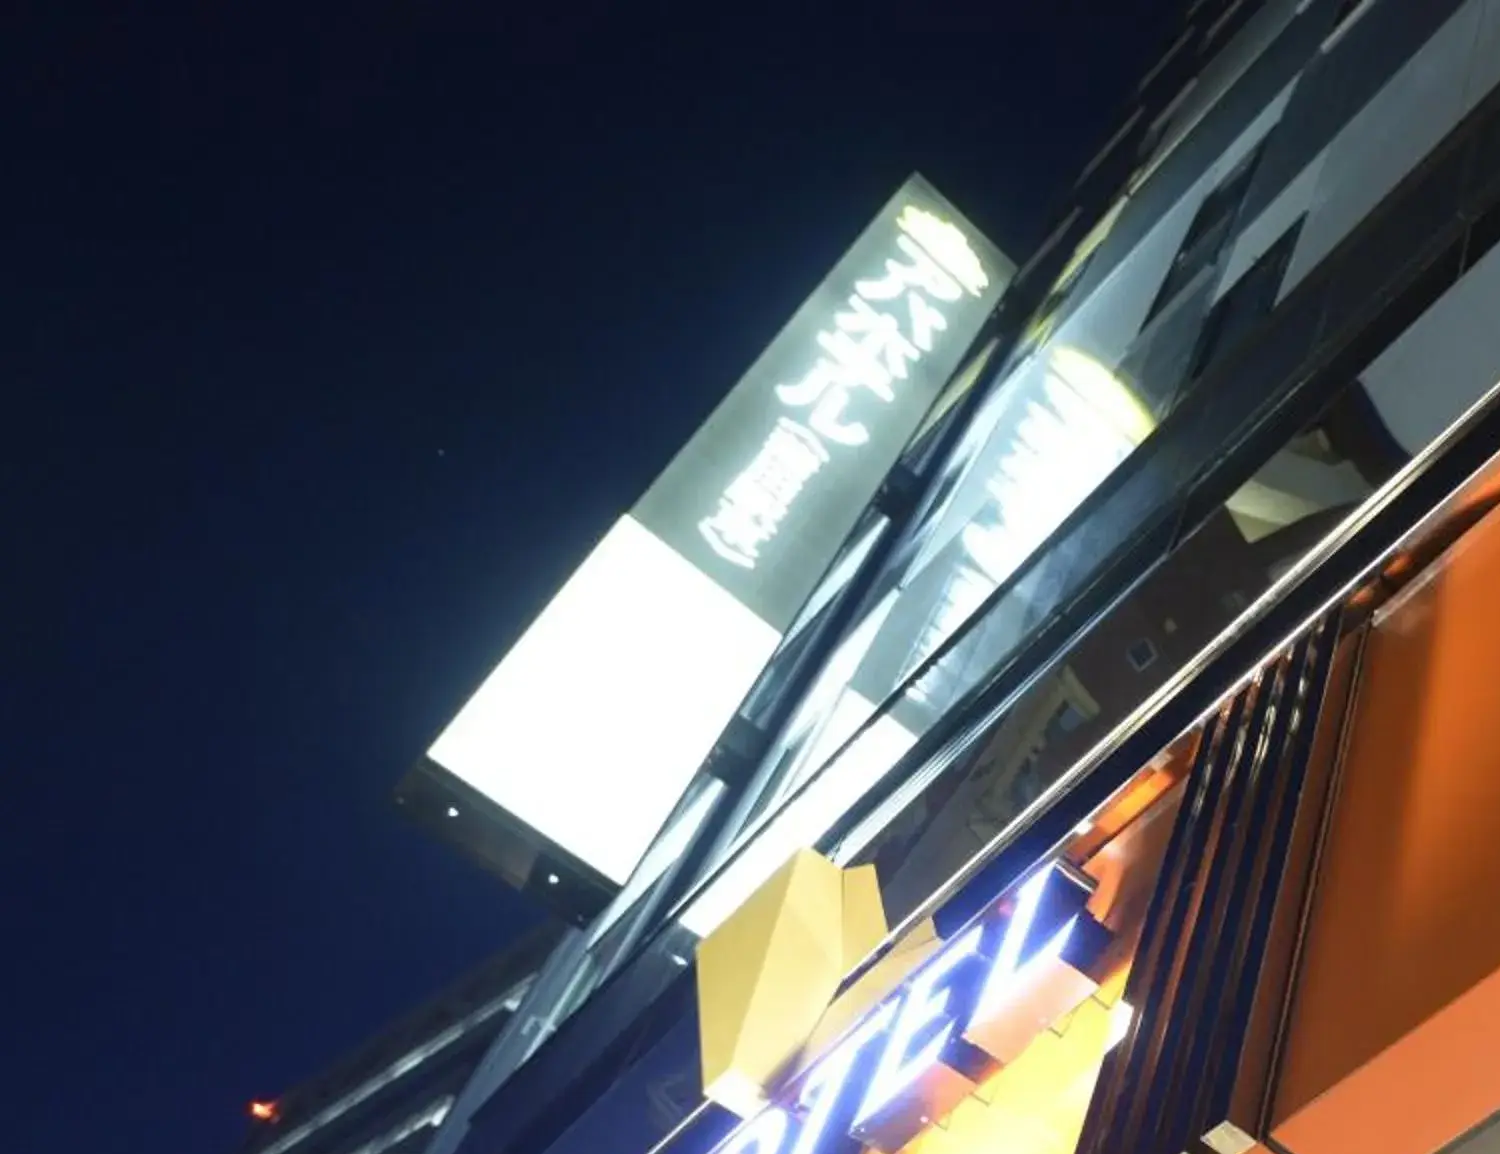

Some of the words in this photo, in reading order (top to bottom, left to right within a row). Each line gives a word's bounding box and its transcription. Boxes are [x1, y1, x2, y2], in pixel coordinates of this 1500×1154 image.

[775, 231, 964, 447] アパホテル
